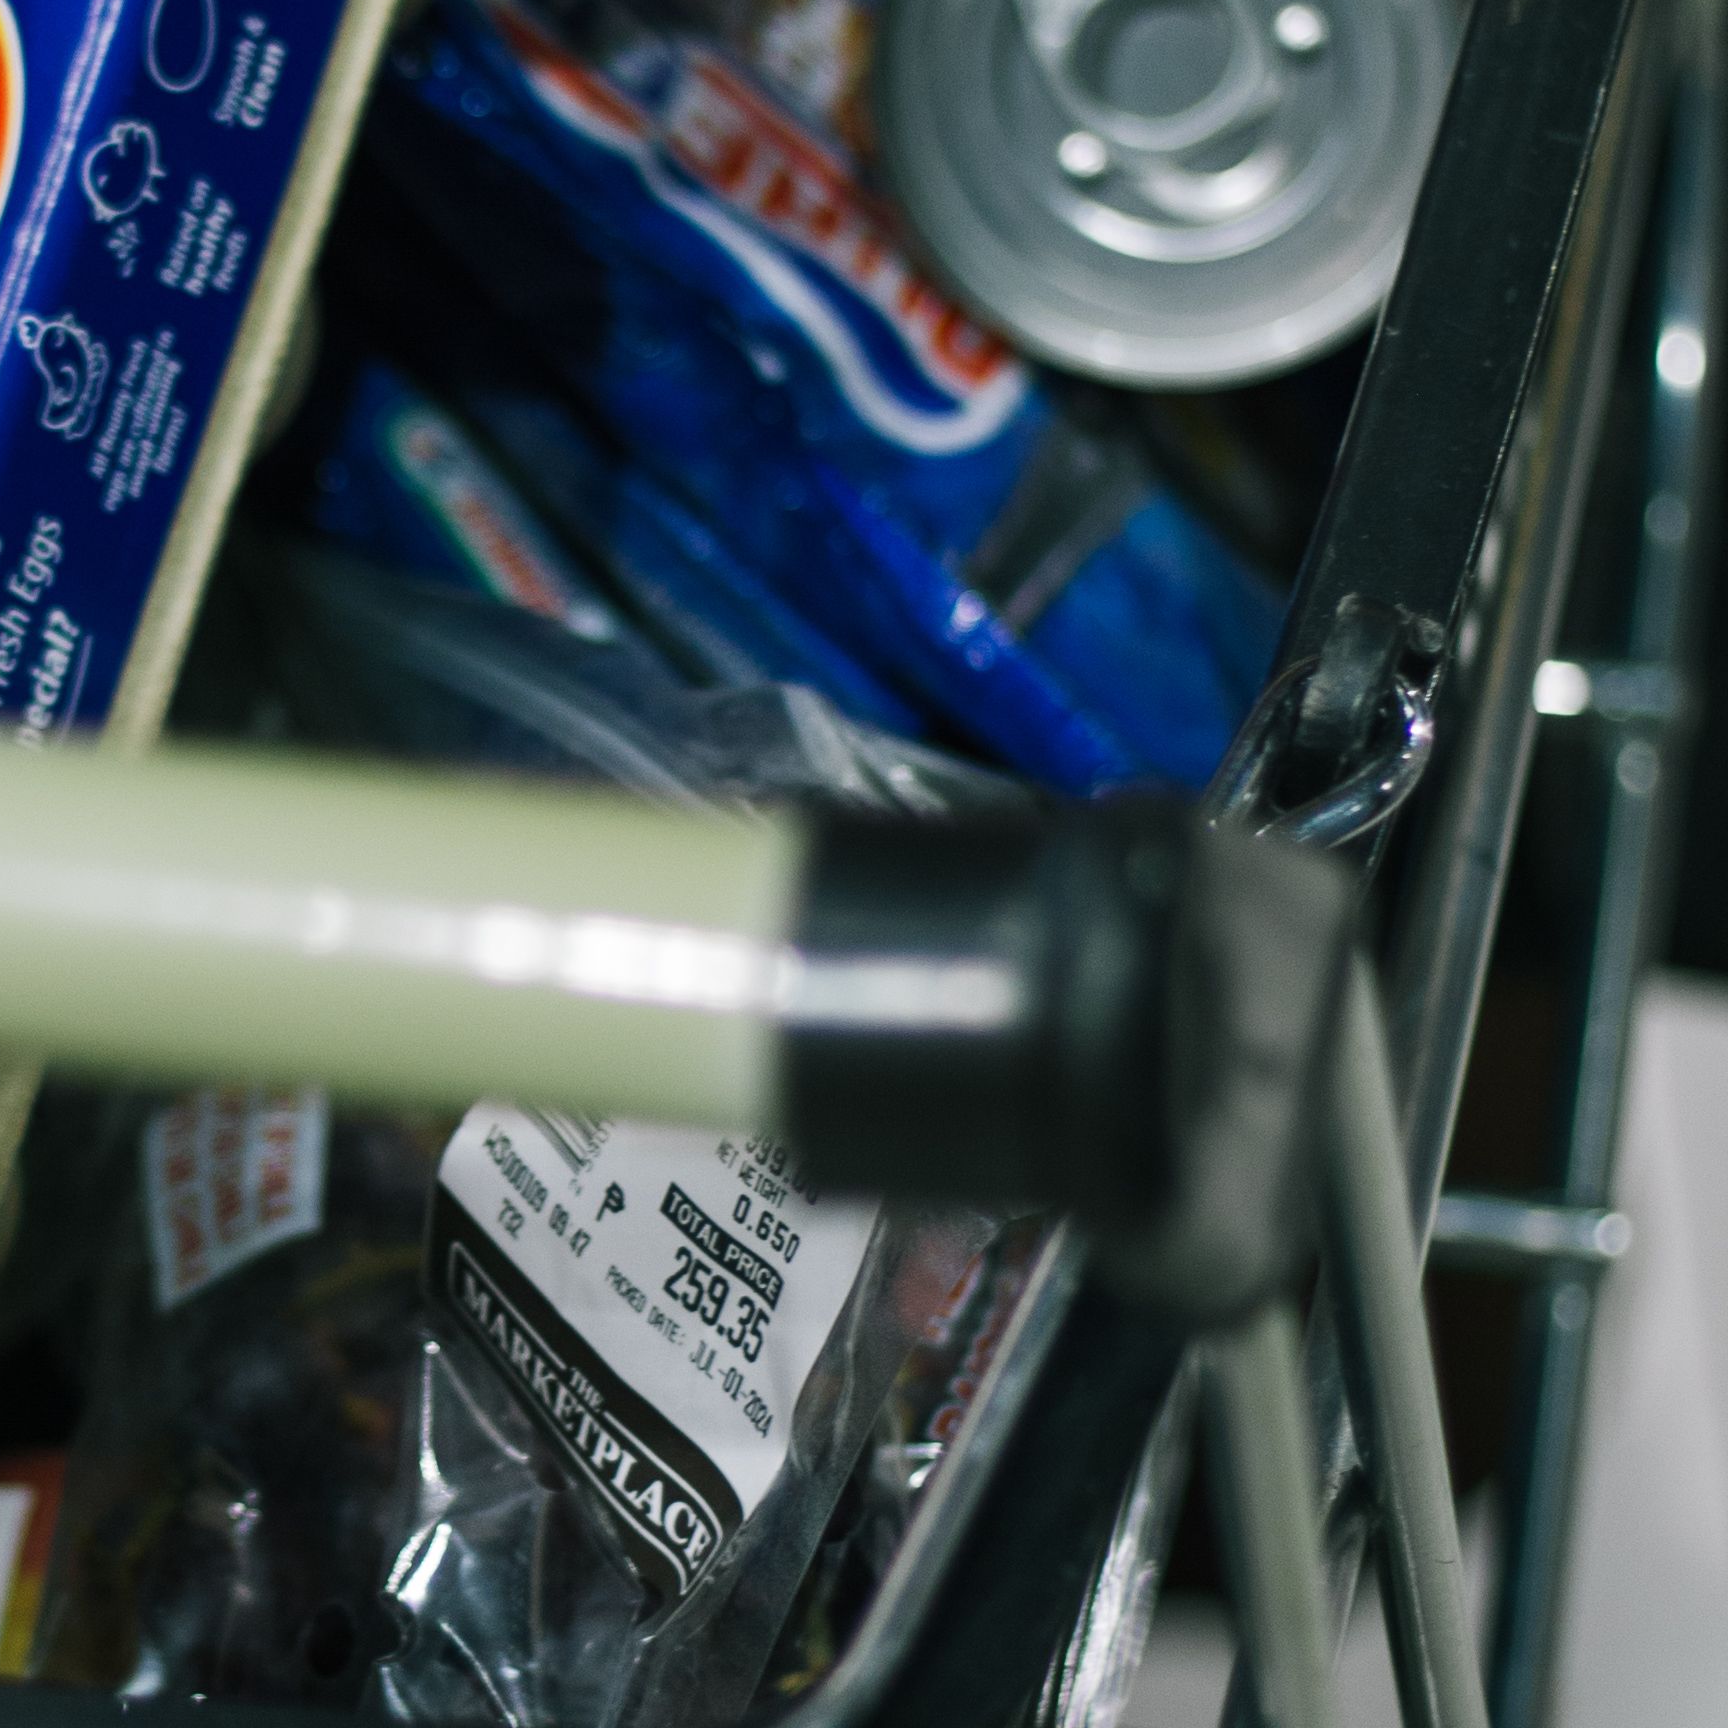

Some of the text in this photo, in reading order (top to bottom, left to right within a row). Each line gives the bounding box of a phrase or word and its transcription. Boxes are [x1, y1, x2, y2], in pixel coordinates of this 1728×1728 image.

[9, 514, 64, 604] Eggs
[733, 1193, 801, 1265] 0.650
[737, 1162, 790, 1212] WEIGHT
[669, 1190, 783, 1302] TOTAL PRICE
[663, 1245, 771, 1365] 259.35
[462, 1271, 713, 1571] MARKETPLACE
[569, 1366, 606, 1412] THE
